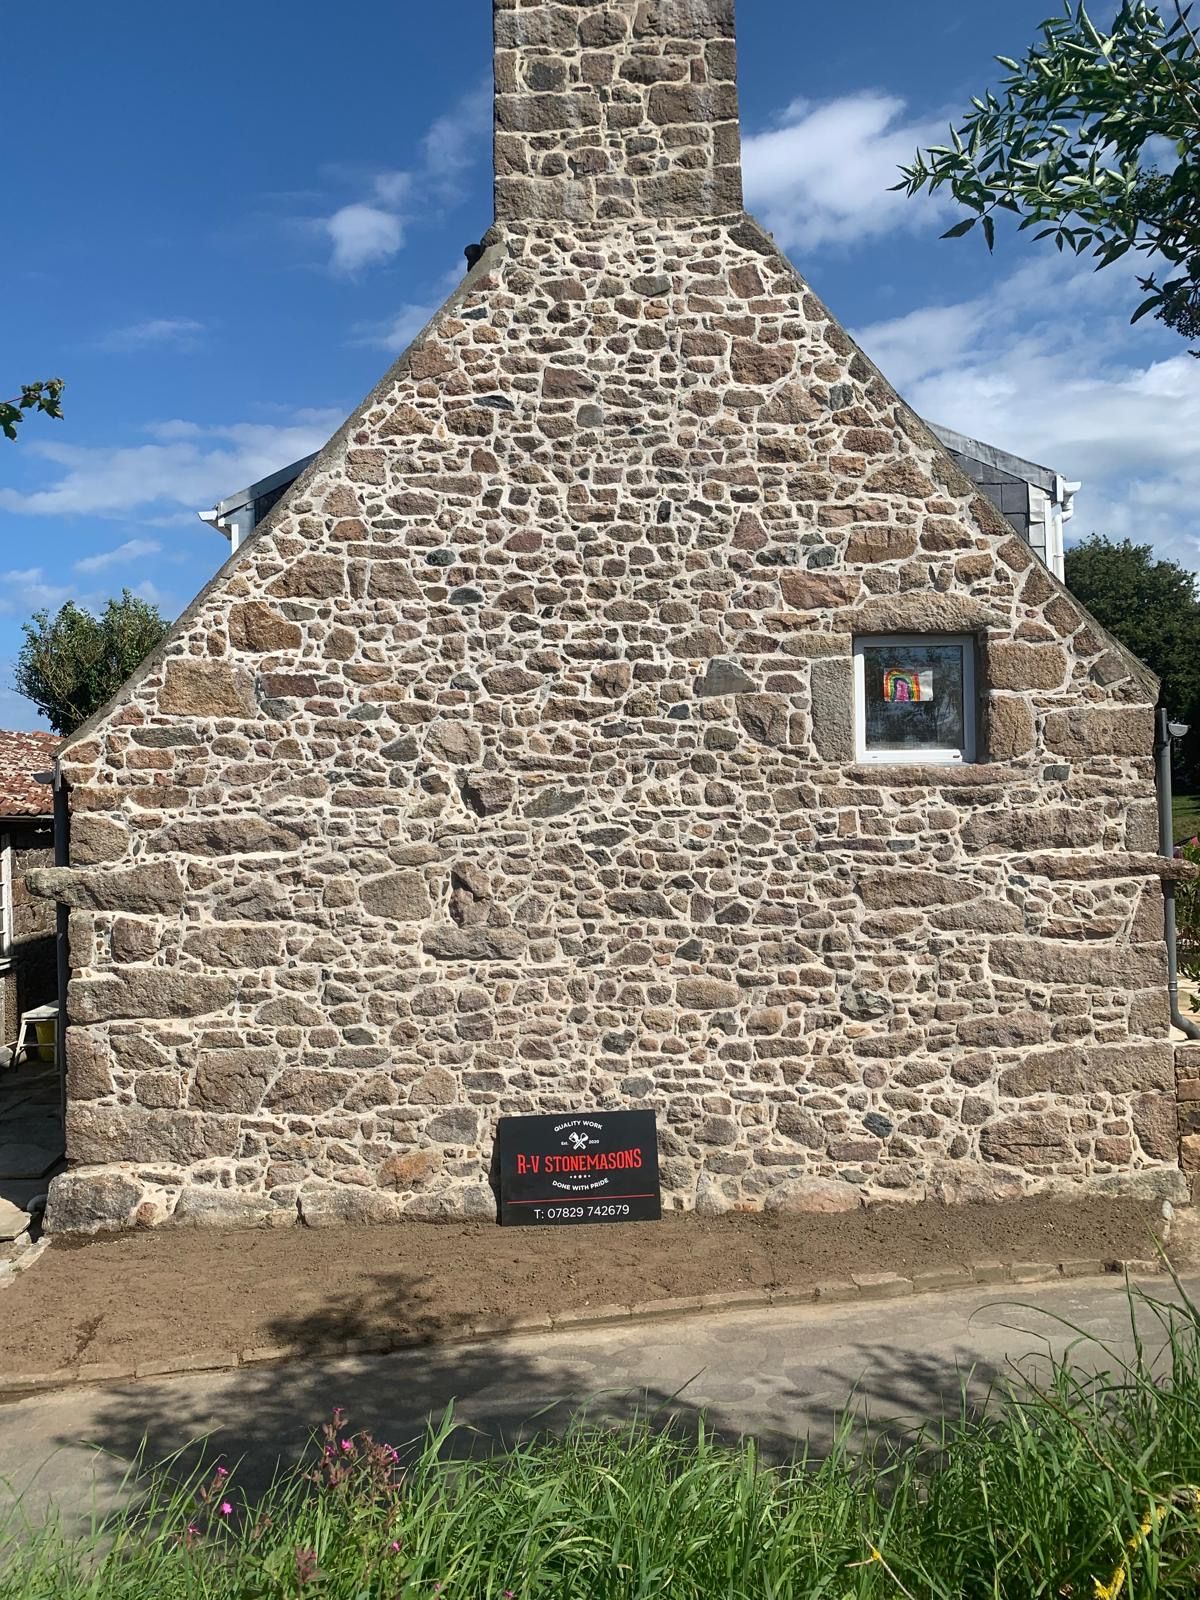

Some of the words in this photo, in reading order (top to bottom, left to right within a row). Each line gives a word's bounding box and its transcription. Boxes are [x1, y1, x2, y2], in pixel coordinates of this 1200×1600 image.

[554, 1120, 581, 1132] QUALITY
[583, 1120, 603, 1130] WORK
[516, 1153, 540, 1174] R-V
[544, 1148, 643, 1173] STONEMASONS
[552, 1180, 571, 1191] DONE
[590, 1177, 609, 1189] PRIDE
[533, 1209, 544, 1219] T:
[547, 1206, 584, 1219] 07829
[587, 1204, 630, 1216] 742679
